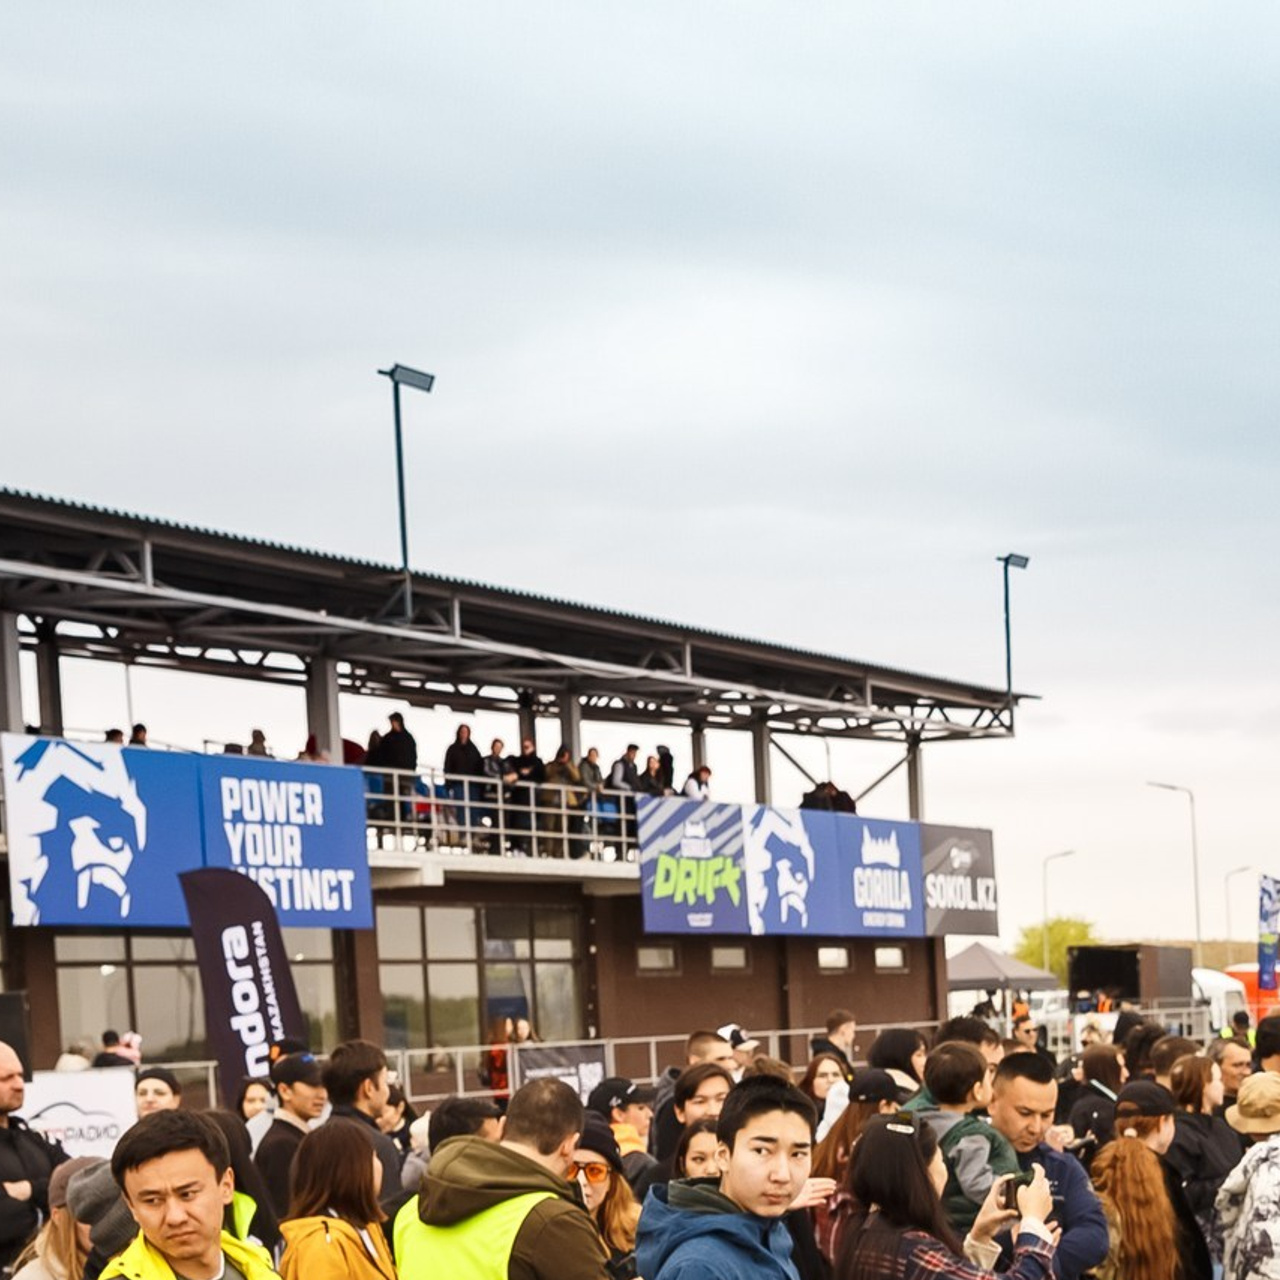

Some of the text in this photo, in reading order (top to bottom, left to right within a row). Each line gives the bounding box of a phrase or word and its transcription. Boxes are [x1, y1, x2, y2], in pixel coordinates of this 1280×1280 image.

[220, 776, 324, 826] POWER
[223, 822, 303, 867] YOUR
[232, 868, 355, 912] STINCT
[853, 867, 912, 911] GORILLA
[925, 873, 997, 912] SOKOL.KZ
[220, 925, 270, 1079] ndora
[251, 920, 286, 1042] KAZAKHSTAN
